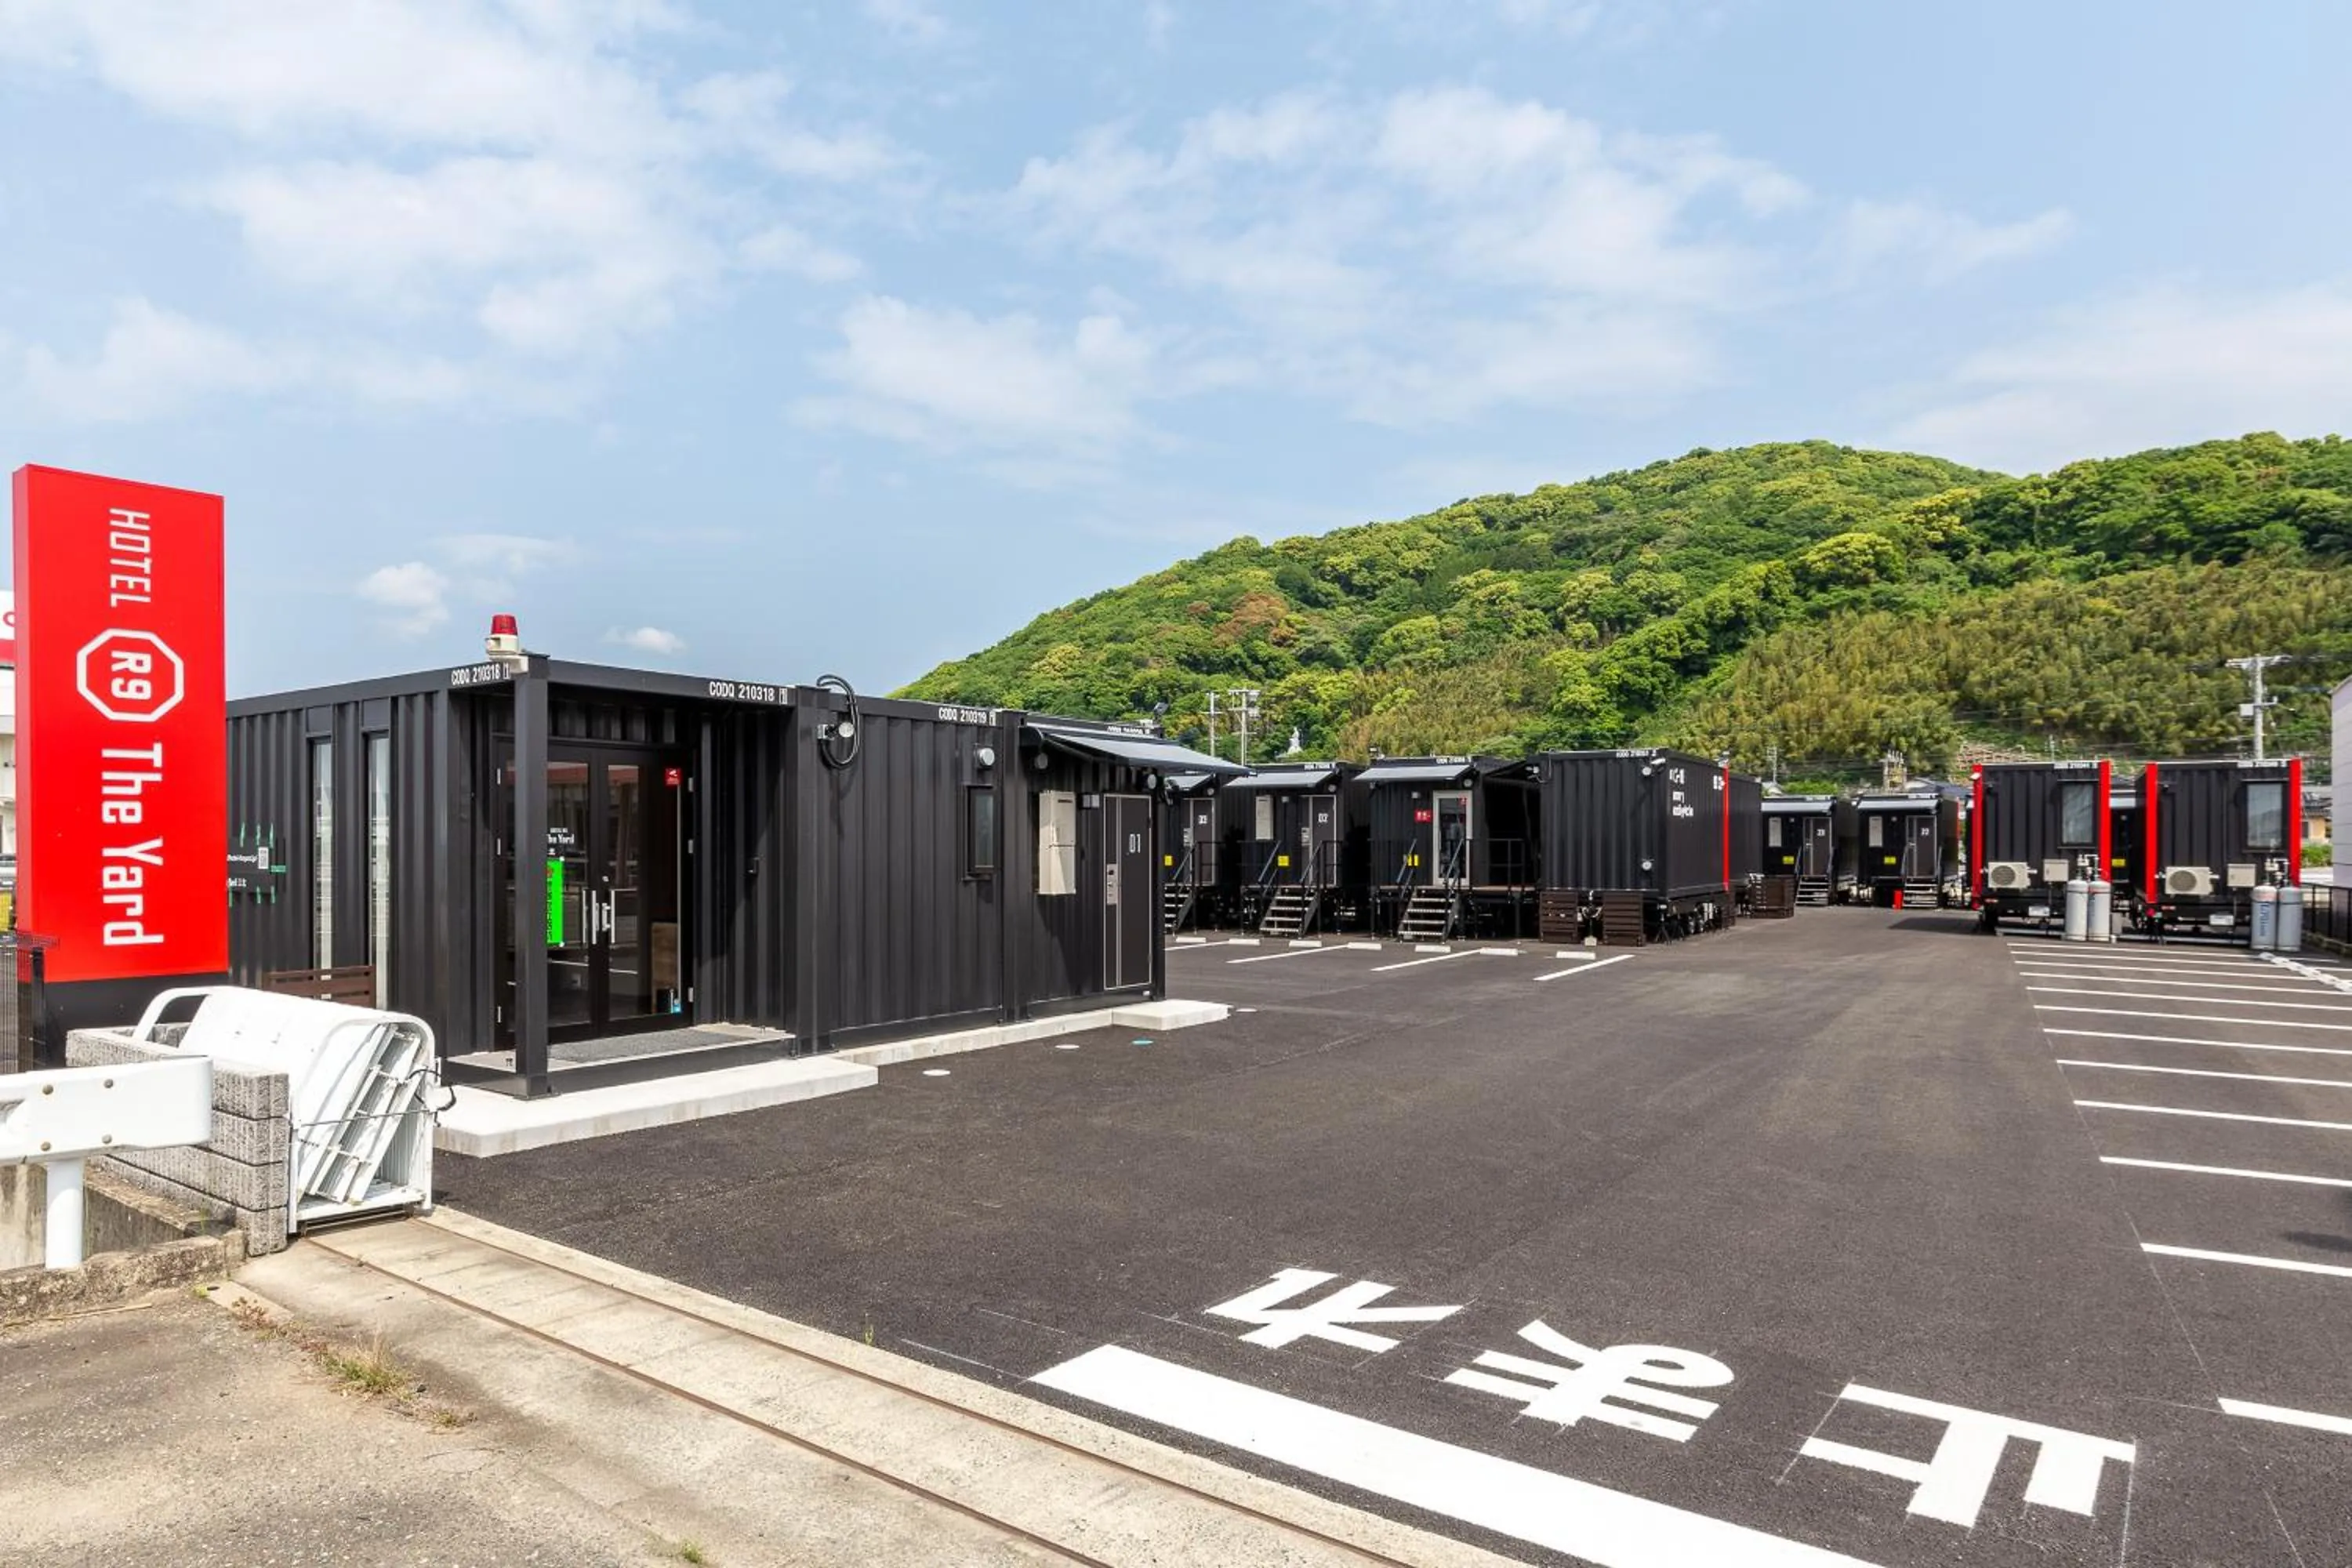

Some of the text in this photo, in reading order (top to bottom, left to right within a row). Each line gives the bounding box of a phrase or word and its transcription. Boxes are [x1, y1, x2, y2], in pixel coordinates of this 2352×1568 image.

[101, 507, 164, 946] HOTEL R9 The Yard
[738, 684, 775, 702] 210318
[1129, 833, 1141, 853] 01
[1203, 1267, 2136, 1528] 止まれ
